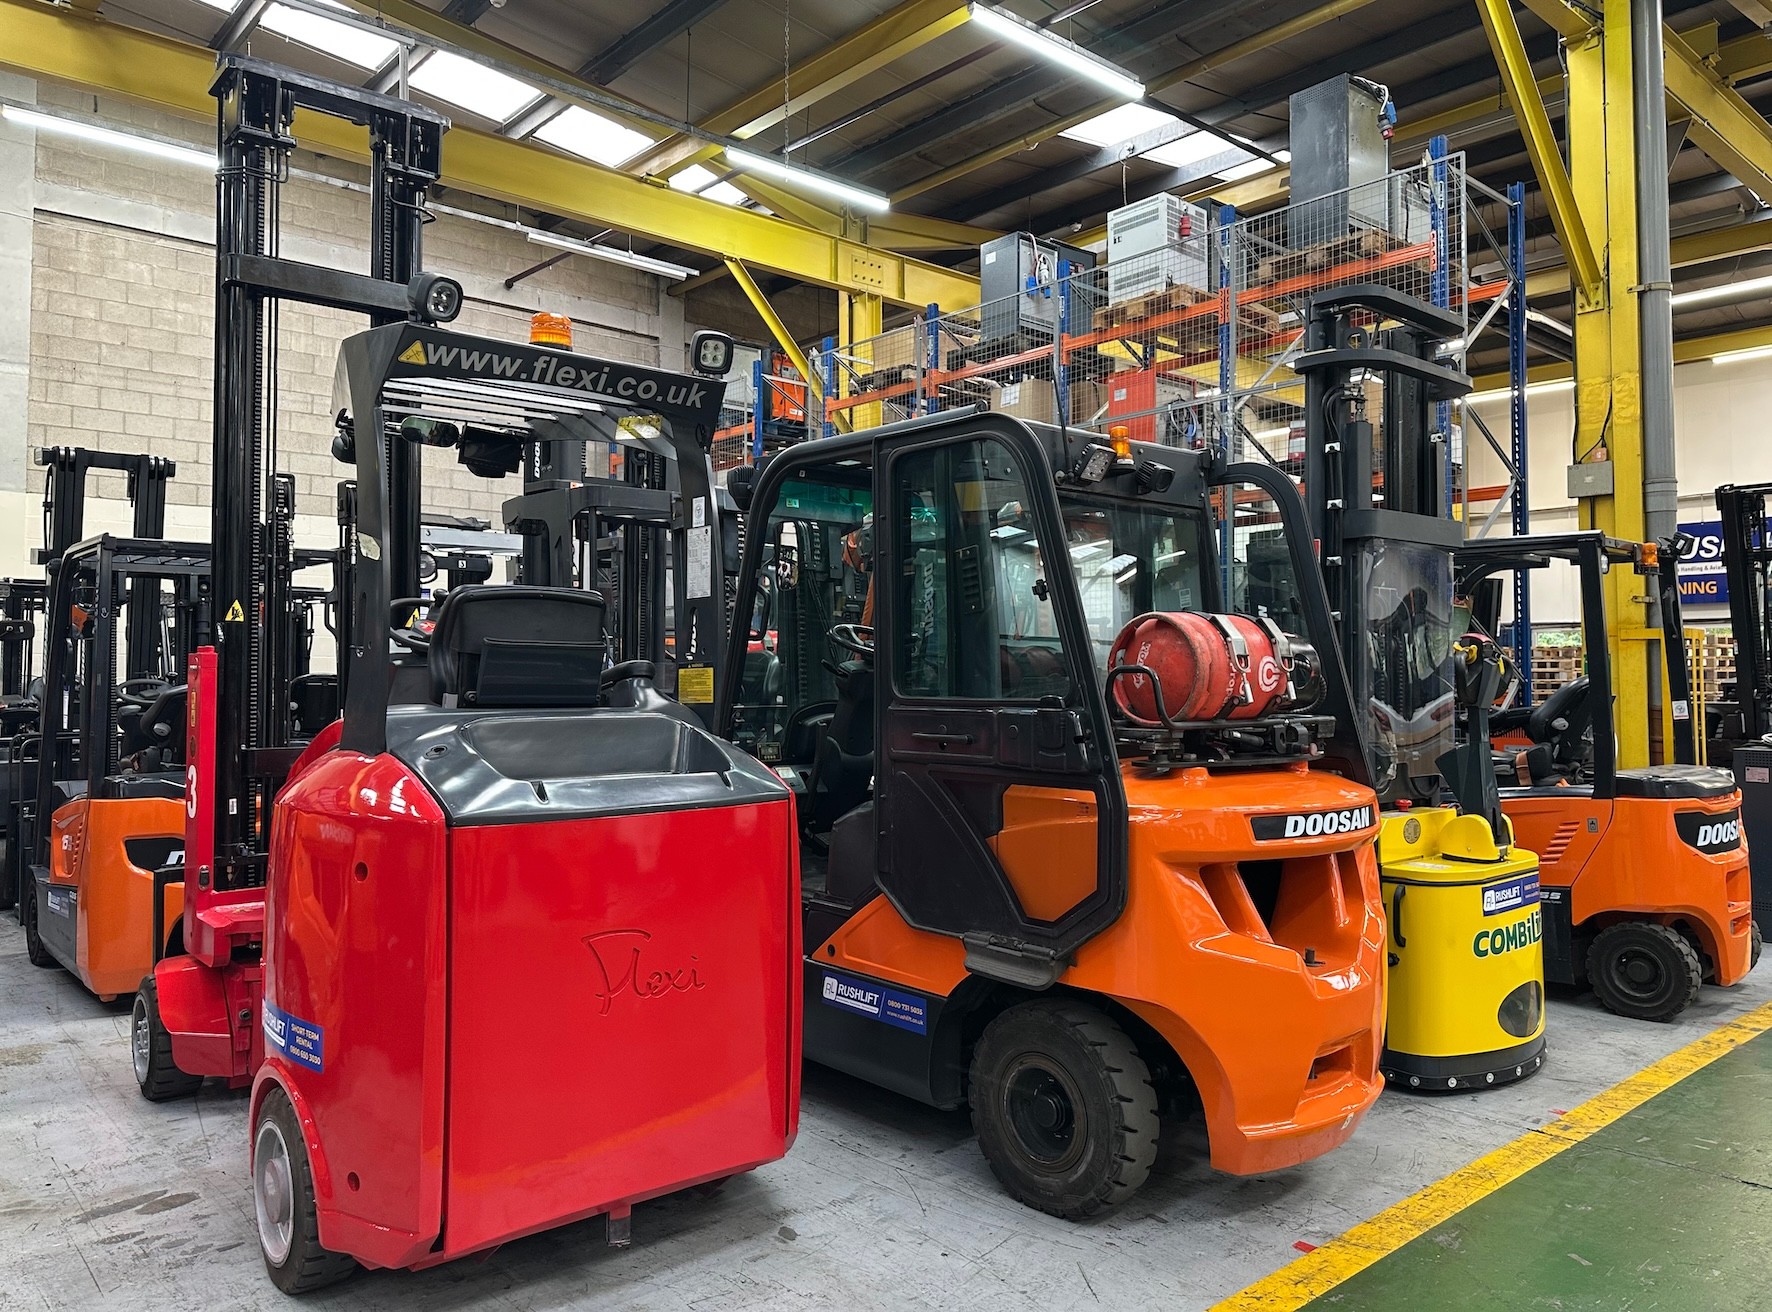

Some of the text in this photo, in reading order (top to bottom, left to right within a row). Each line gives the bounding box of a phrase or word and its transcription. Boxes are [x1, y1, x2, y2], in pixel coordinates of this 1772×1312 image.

[427, 342, 708, 409] www.flexi.co.uk
[187, 764, 198, 819] 3
[1284, 806, 1370, 838] DOOSAN
[1495, 885, 1521, 902] RUSHLIFT
[580, 928, 706, 1017] Flexi
[837, 983, 880, 1006] RUSHLIFT
[295, 1035, 313, 1050] RENTAL
